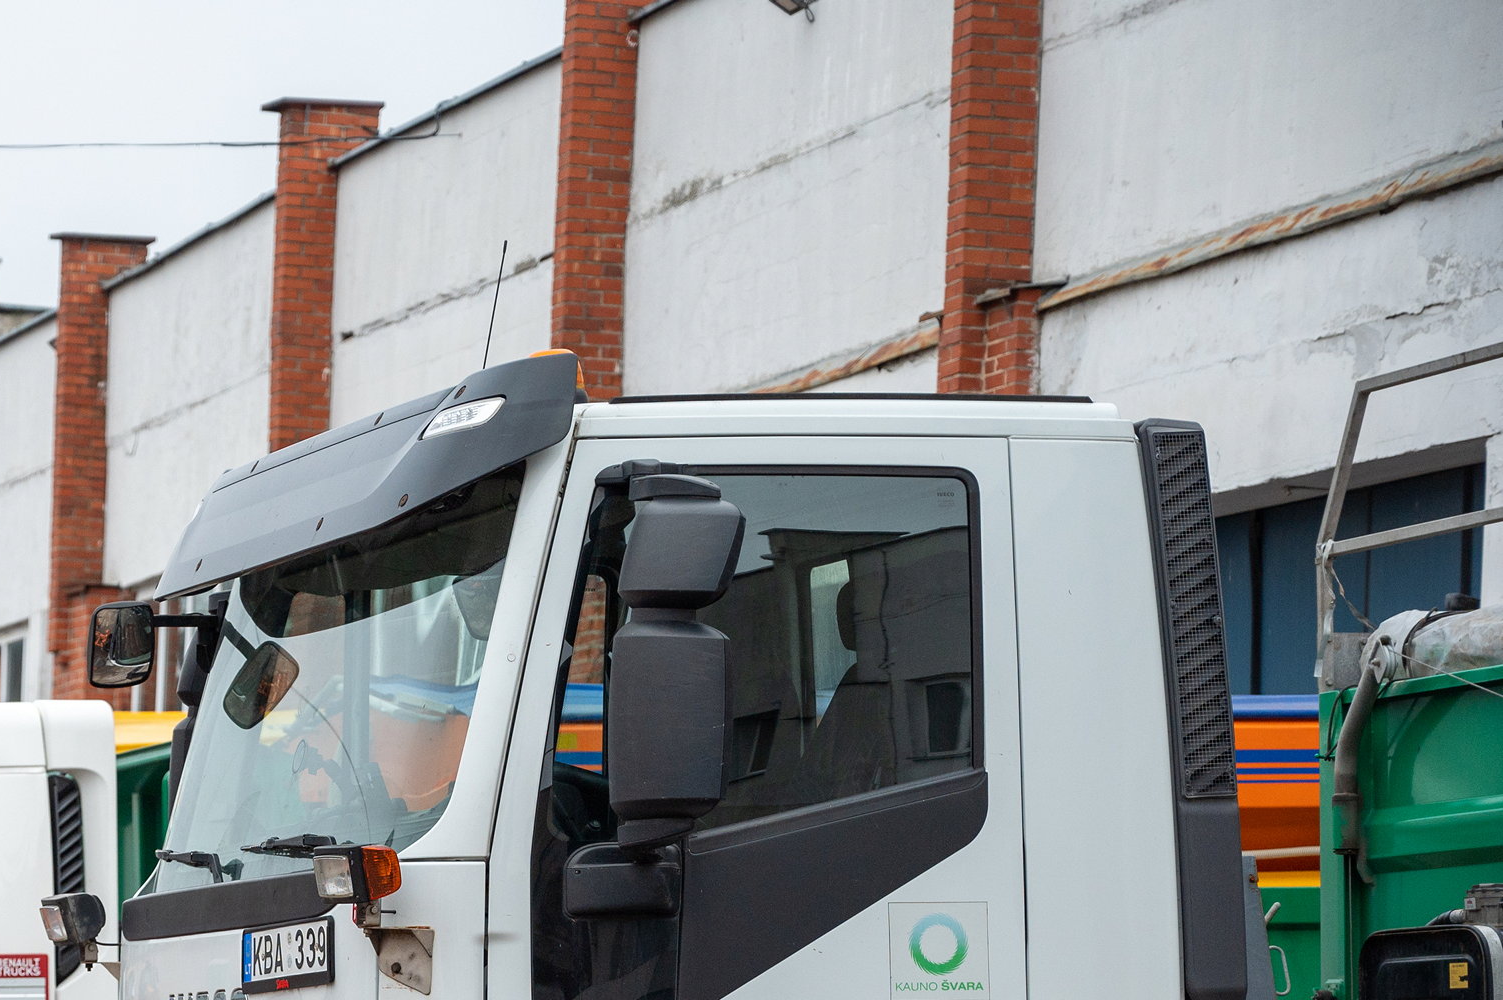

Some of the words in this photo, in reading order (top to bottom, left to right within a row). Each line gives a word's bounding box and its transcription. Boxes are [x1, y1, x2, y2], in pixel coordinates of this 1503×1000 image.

[253, 932, 284, 977] KBA
[295, 926, 326, 970] 339
[895, 981, 938, 992] KAUNO
[941, 979, 984, 992] ŠVARA
